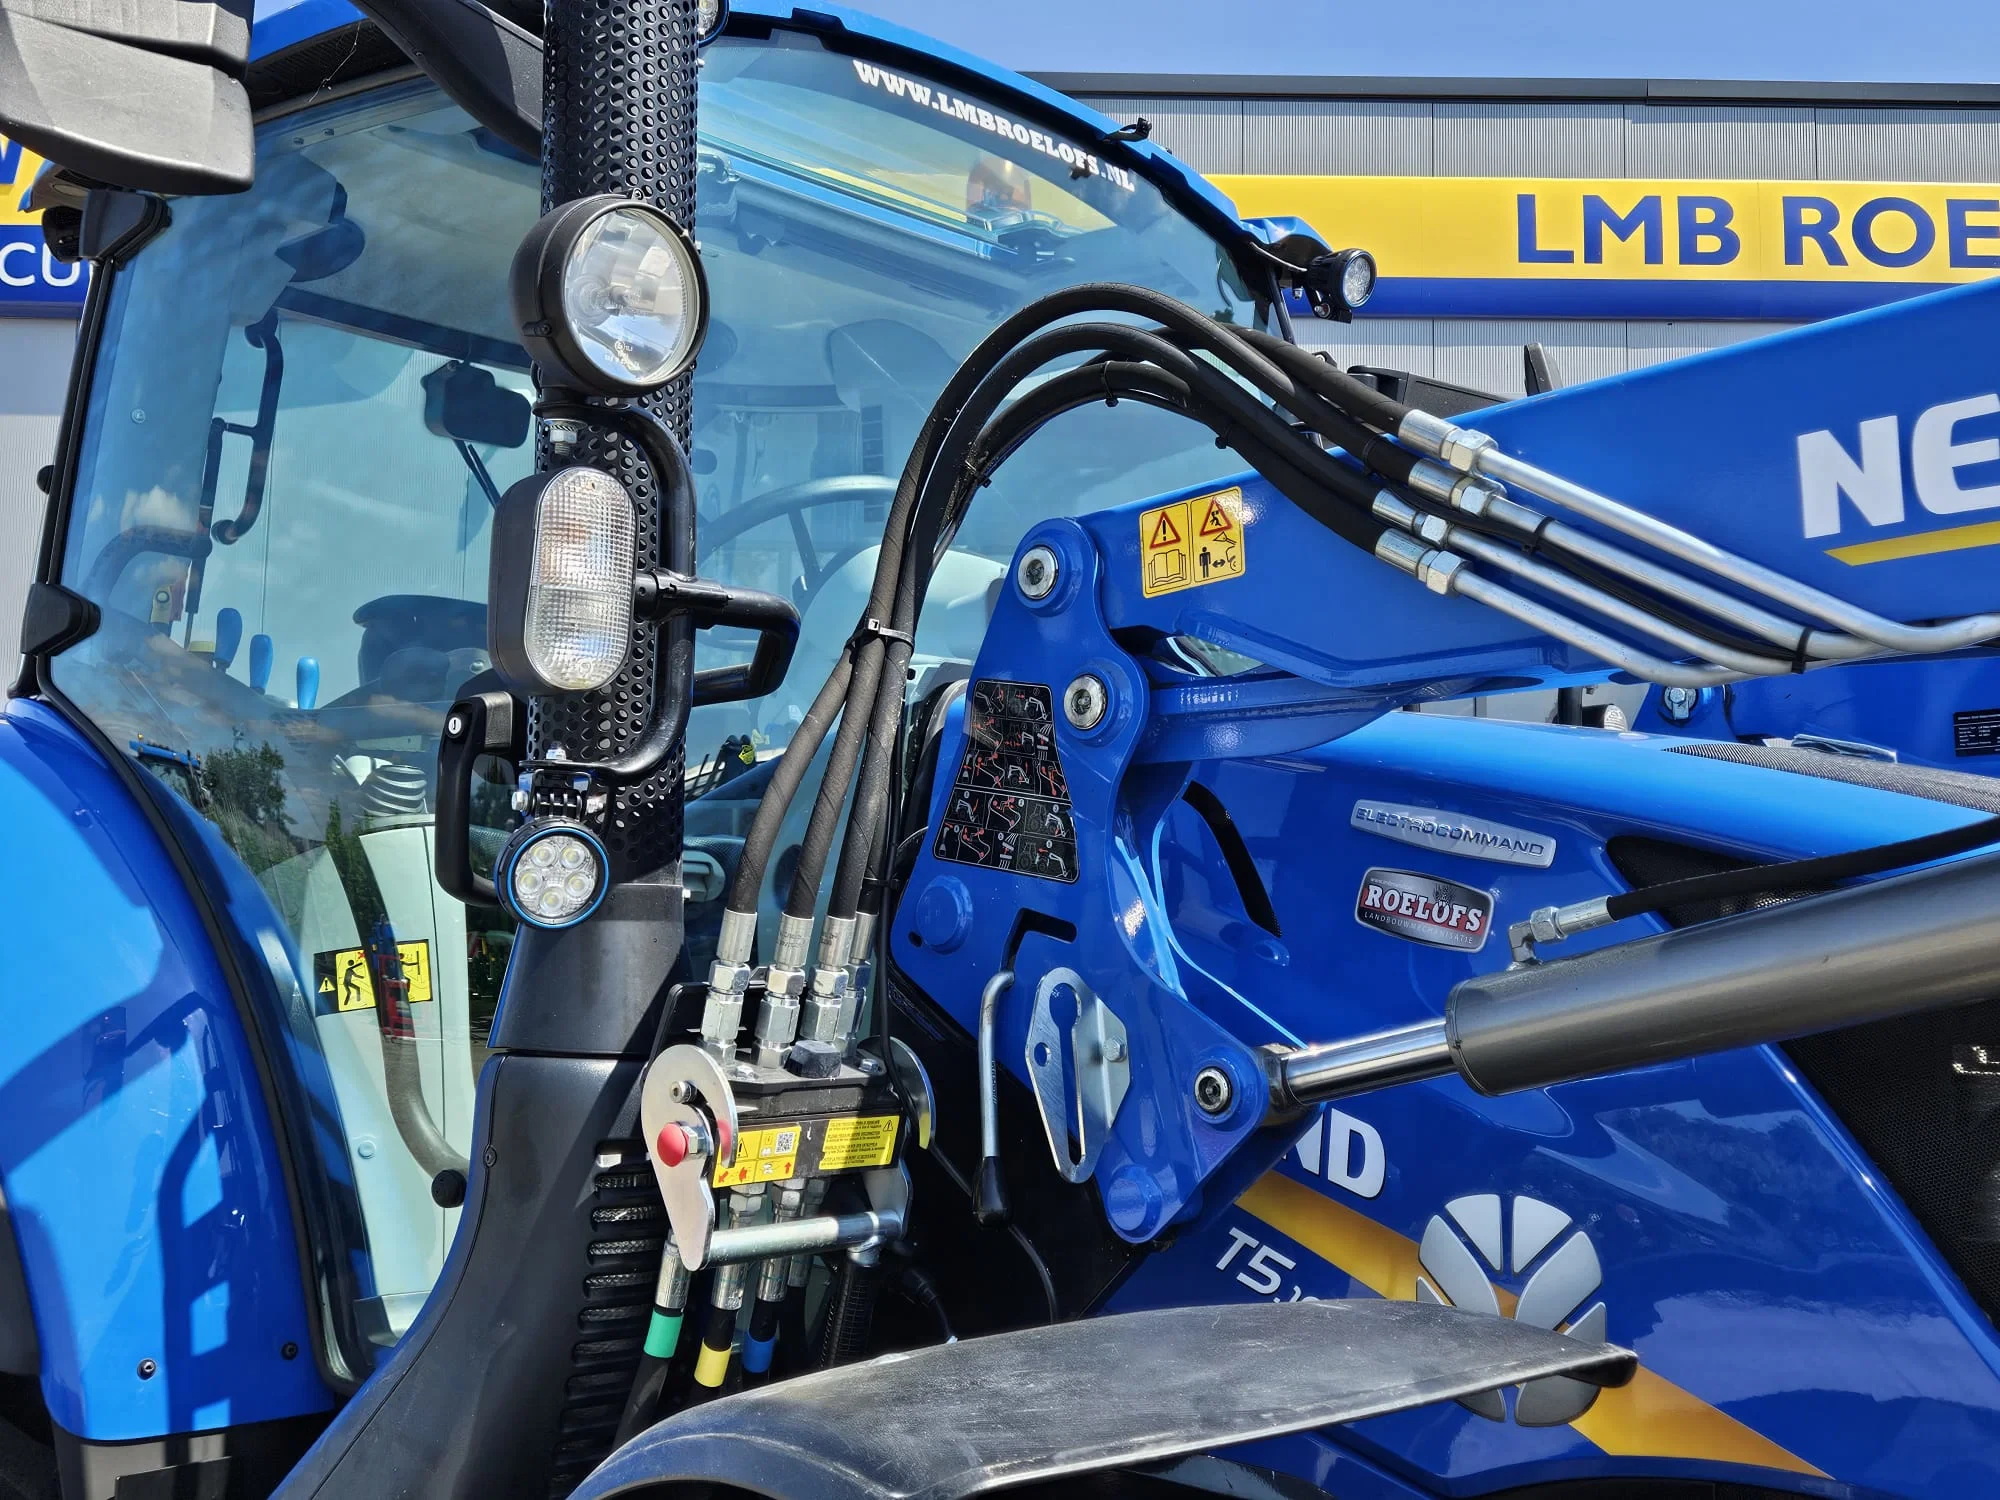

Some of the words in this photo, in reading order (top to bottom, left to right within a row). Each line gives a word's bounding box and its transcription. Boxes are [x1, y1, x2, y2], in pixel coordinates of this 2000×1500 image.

[852, 59, 1135, 192] WWW.LMBROELOFS.NL
[1516, 193, 1741, 266] LMB
[1782, 196, 2000, 269] ROE
[1797, 393, 2000, 540] NE
[1355, 807, 1545, 857] ELECTROCOMMAND
[1364, 884, 1483, 932] ROELOFS
[1216, 1227, 1321, 1303] T5.1
